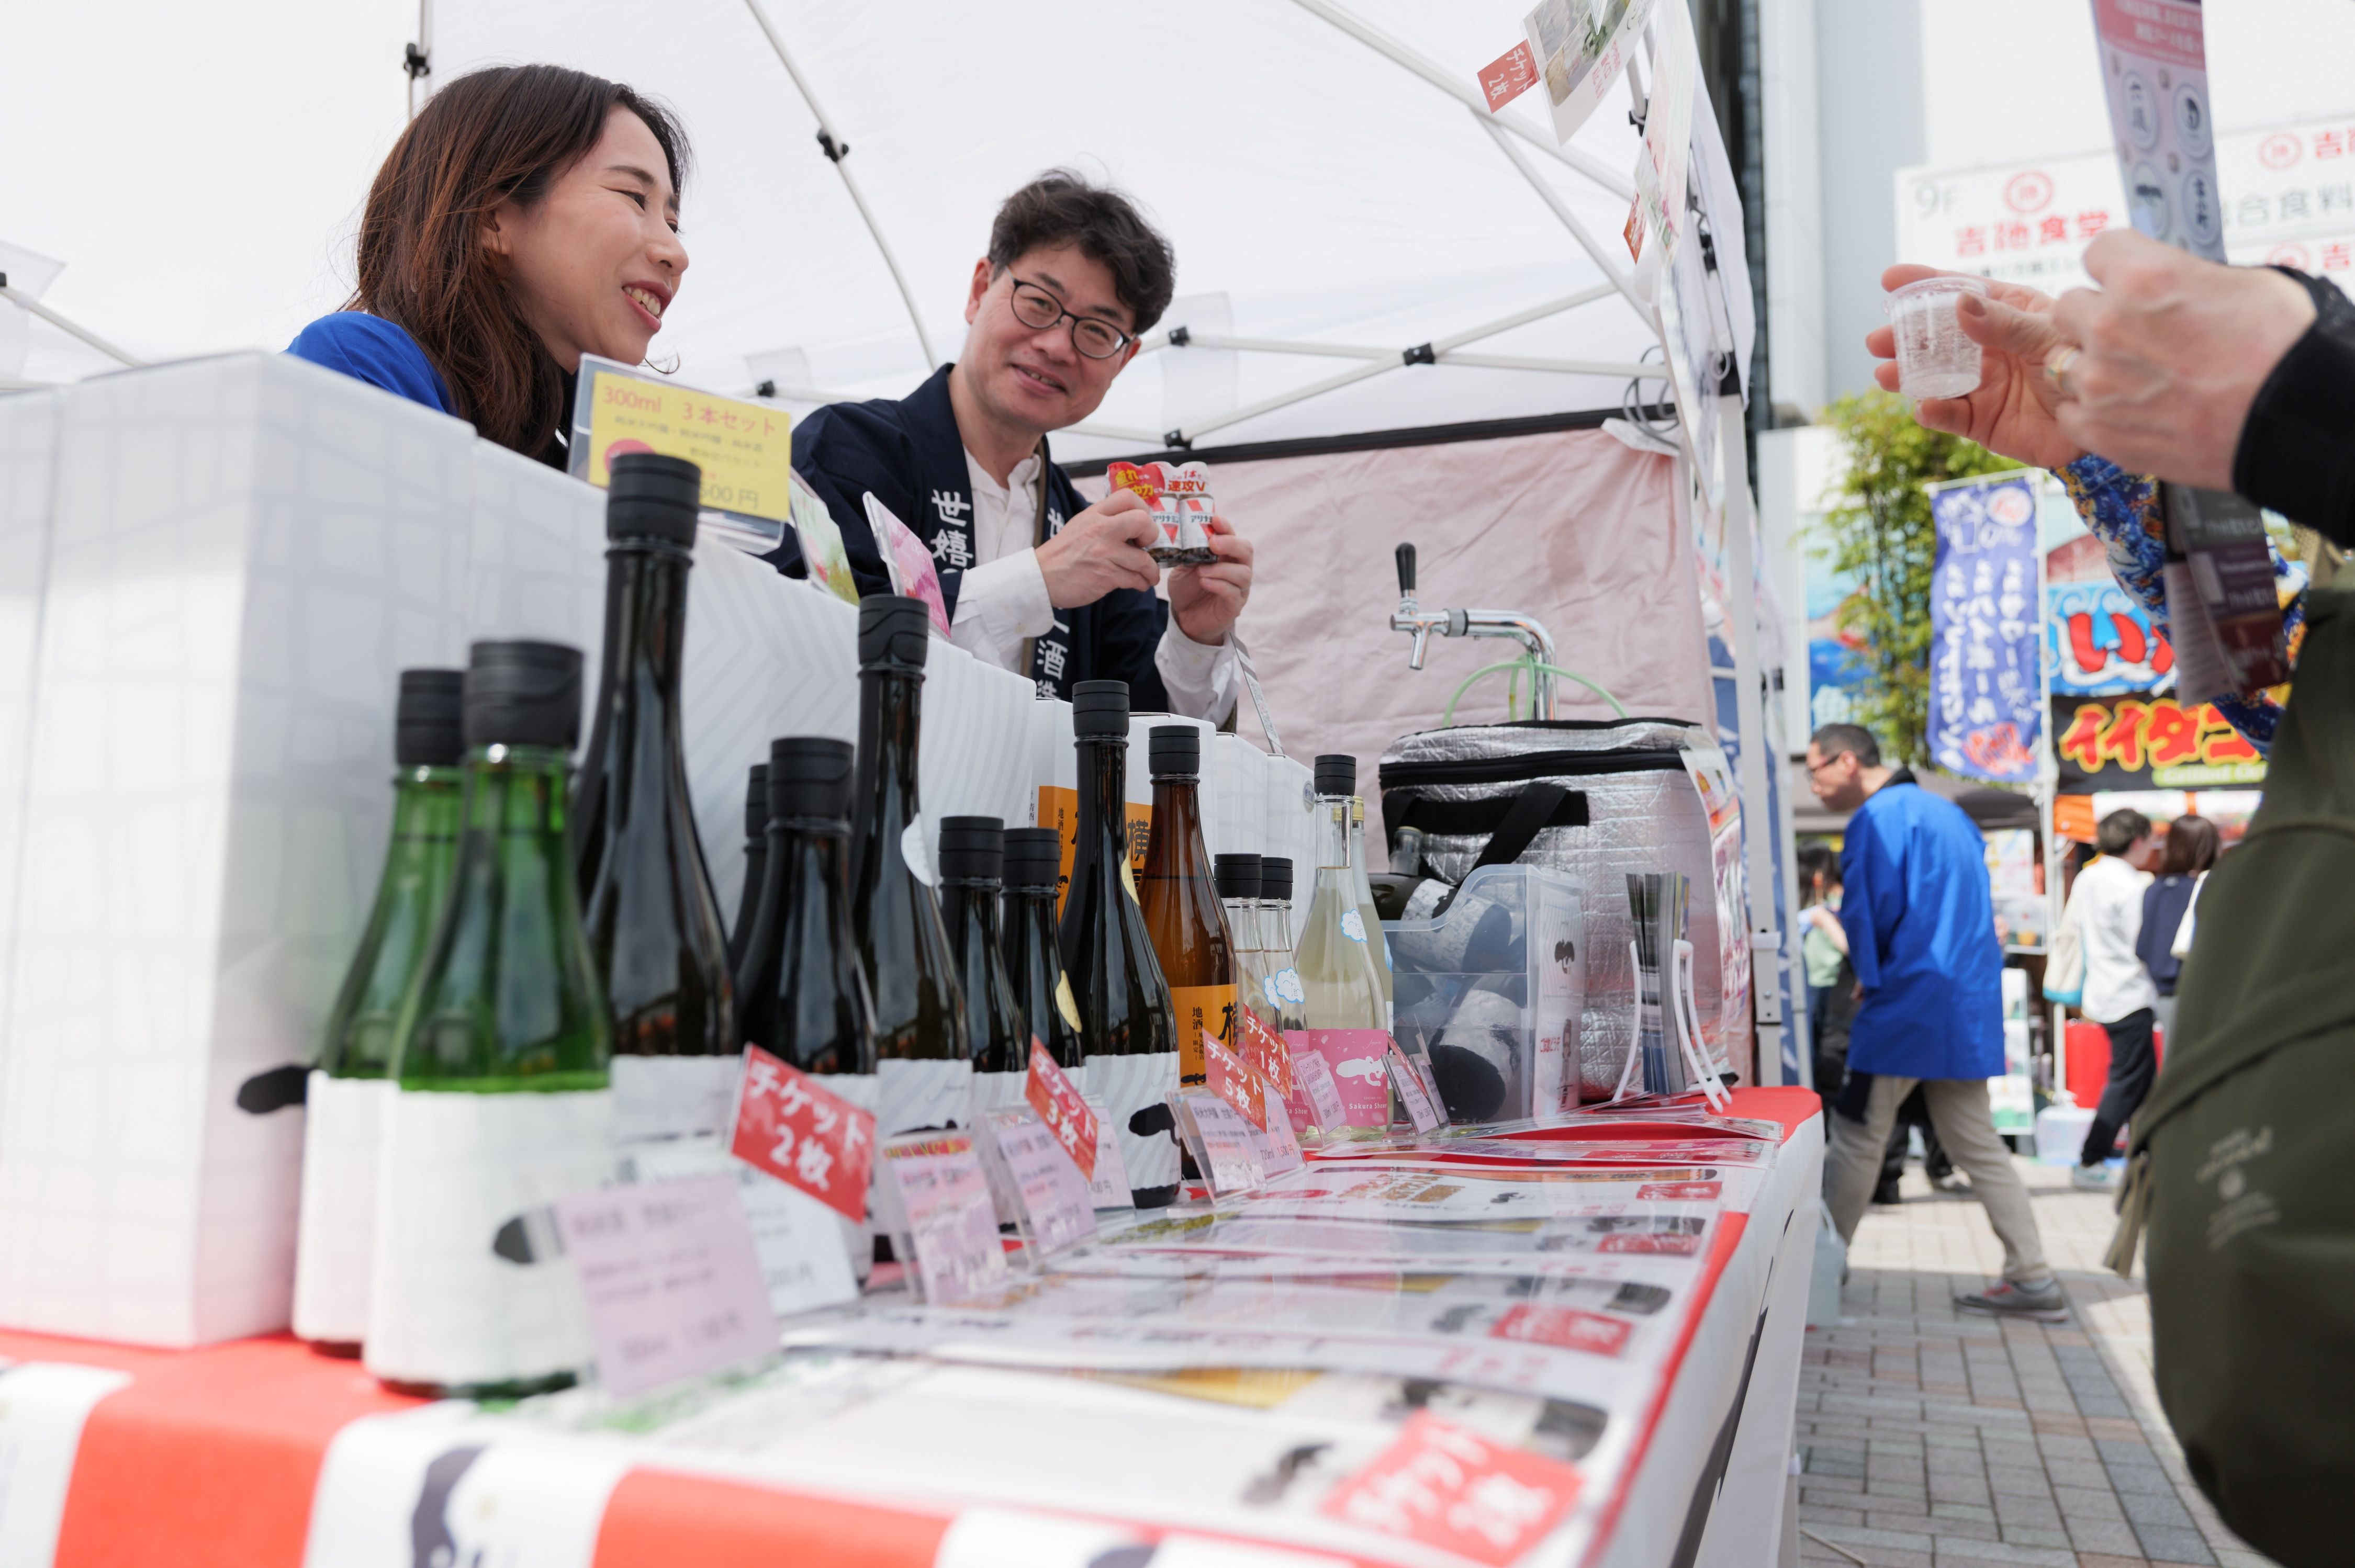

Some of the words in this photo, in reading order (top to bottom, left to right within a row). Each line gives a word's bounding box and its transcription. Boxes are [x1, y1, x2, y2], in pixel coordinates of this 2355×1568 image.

[1488, 73, 1509, 100] 2枚
[1506, 48, 1533, 91] チケット
[603, 386, 662, 413] 300ml
[1168, 480, 1206, 492] 速攻V
[931, 489, 974, 573] 世嬉
[1192, 1007, 1203, 1030] 地酒
[1247, 1016, 1289, 1064] チケット
[1207, 1041, 1261, 1096] チケット
[1260, 1051, 1280, 1084] 1枚
[749, 1059, 867, 1152] チケット
[1035, 1050, 1095, 1139] チケット
[1225, 1076, 1251, 1114] 5枚
[1047, 1098, 1078, 1156] 3枚
[769, 1124, 834, 1192] 2枚
[1260, 1149, 1275, 1160] 720ml
